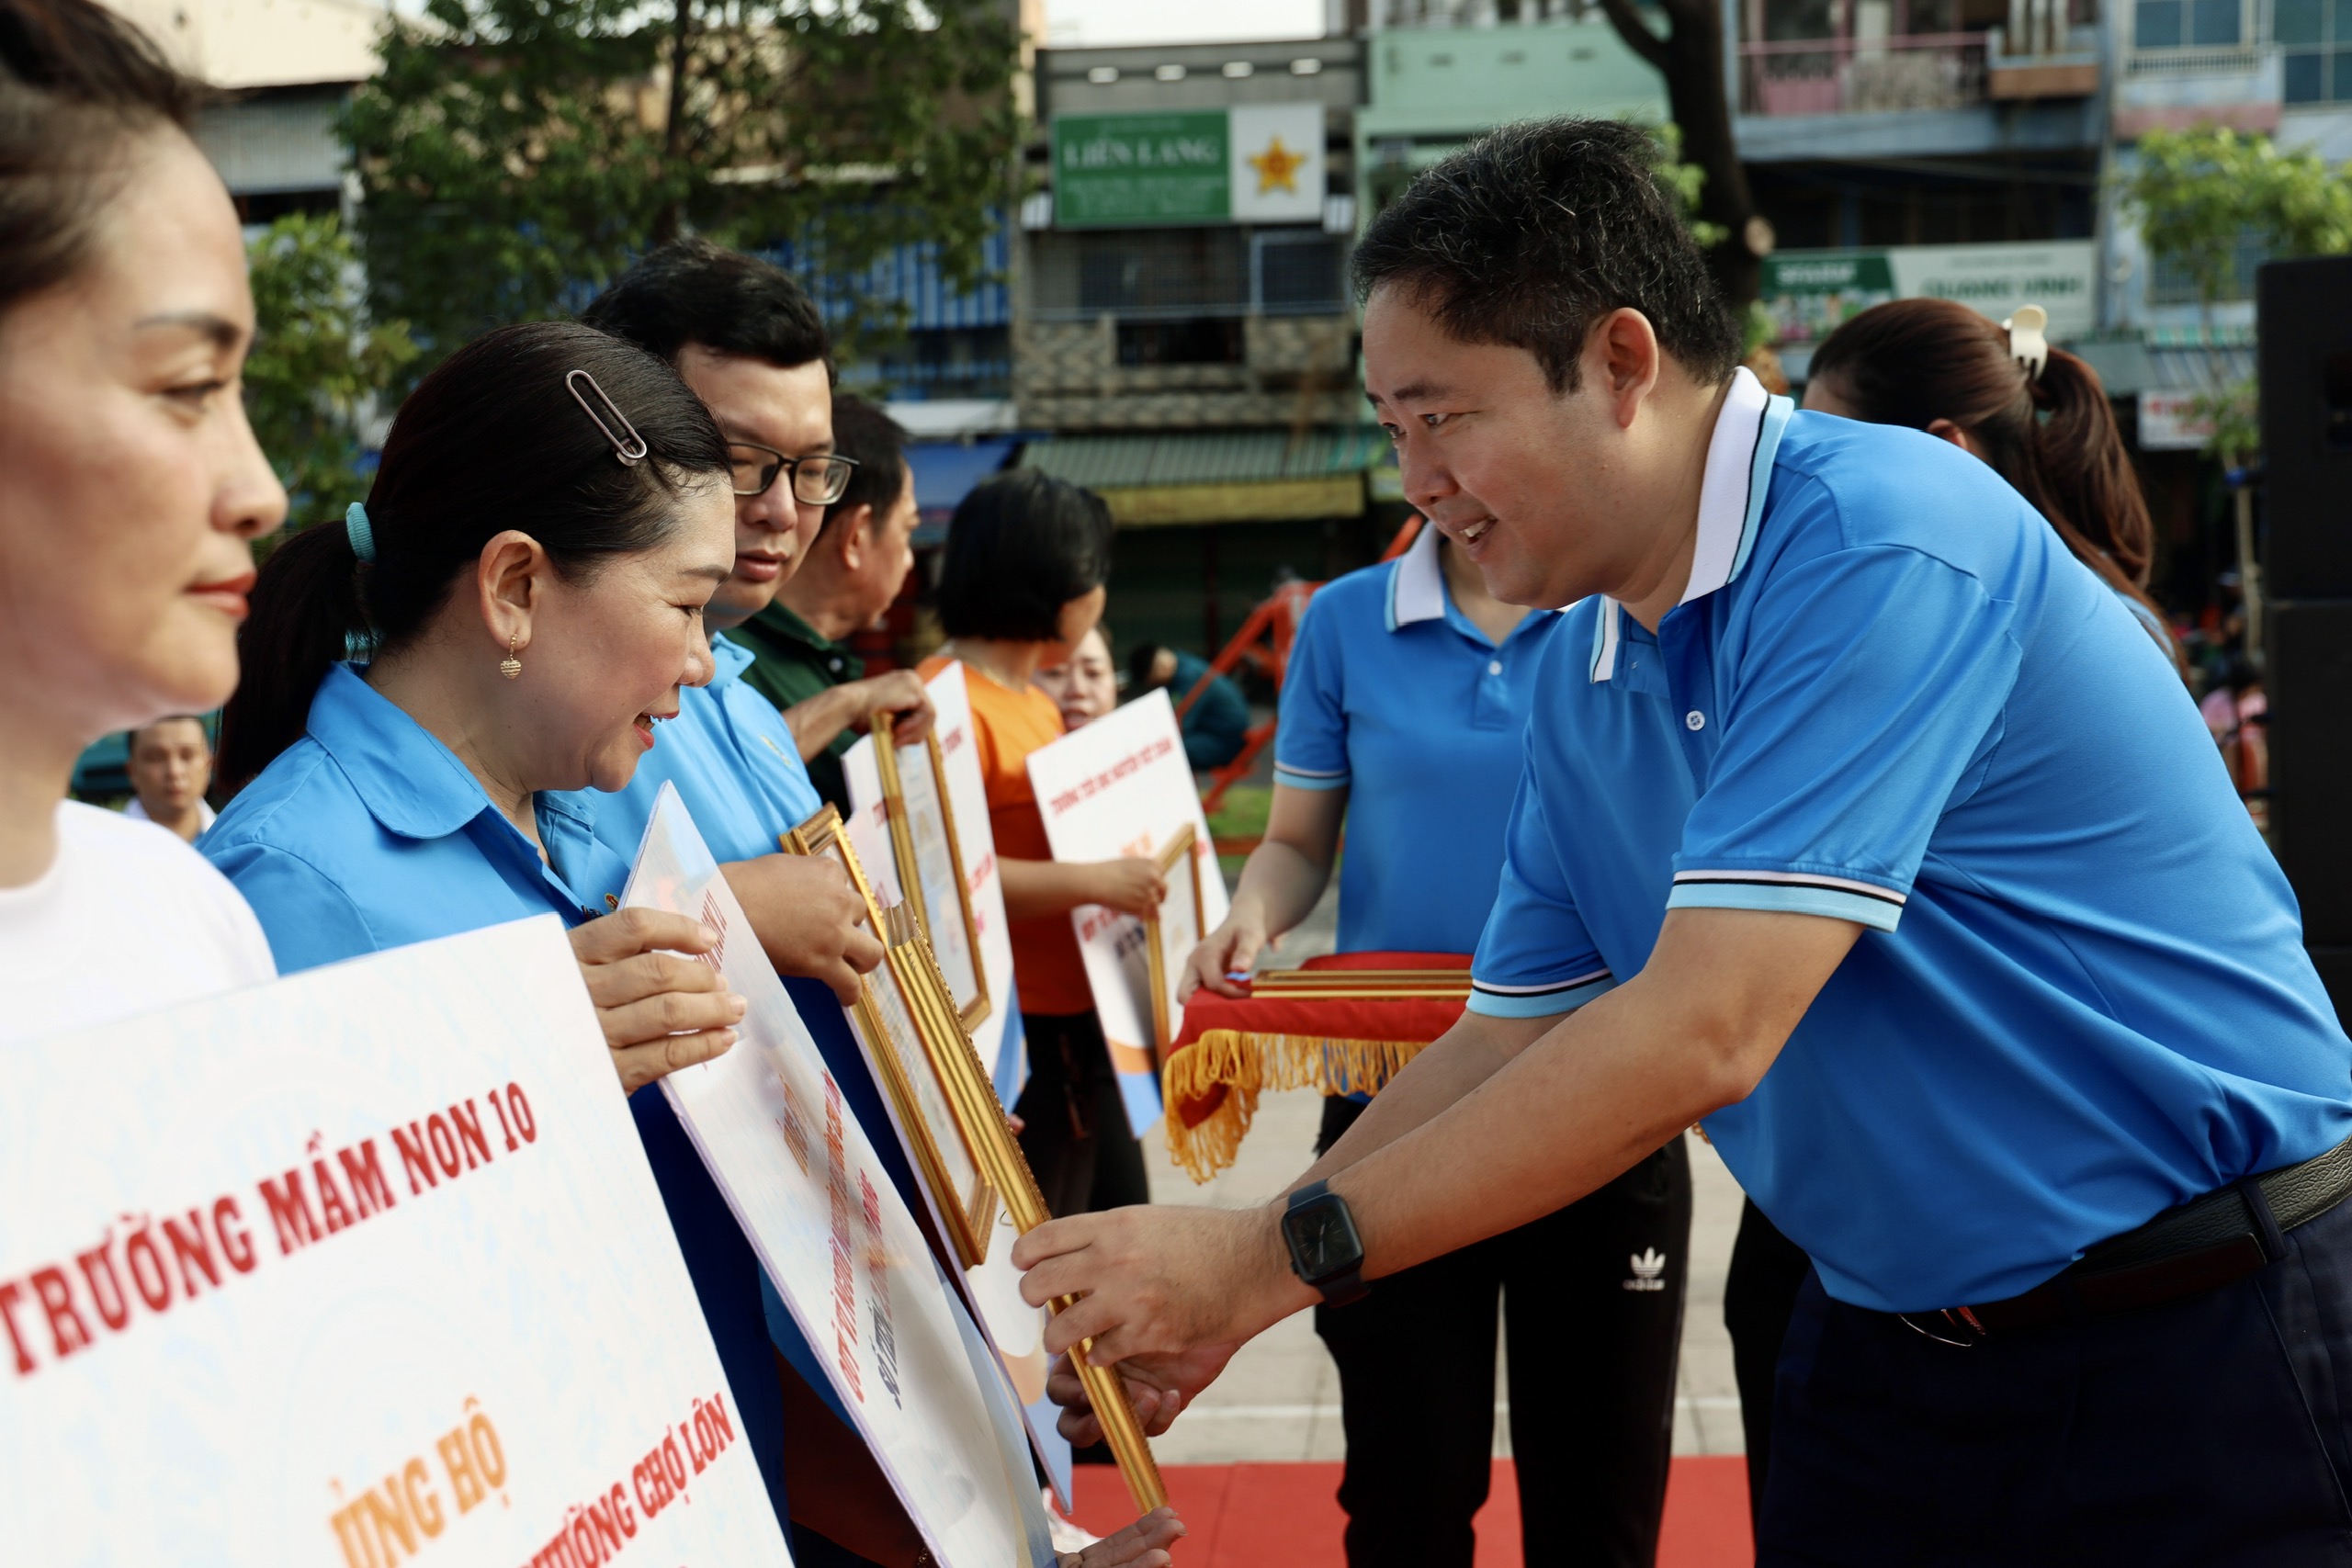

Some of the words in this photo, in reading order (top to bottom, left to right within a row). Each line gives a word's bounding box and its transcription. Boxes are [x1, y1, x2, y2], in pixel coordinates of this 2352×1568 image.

[0, 1196, 257, 1375] TRƯỜNG
[257, 1130, 397, 1257] MẦM
[390, 1098, 493, 1198] NON
[488, 1082, 537, 1153] 10
[435, 1393, 512, 1516] HỘ
[632, 1424, 690, 1520] CHỢ
[679, 1392, 735, 1476] LỚN
